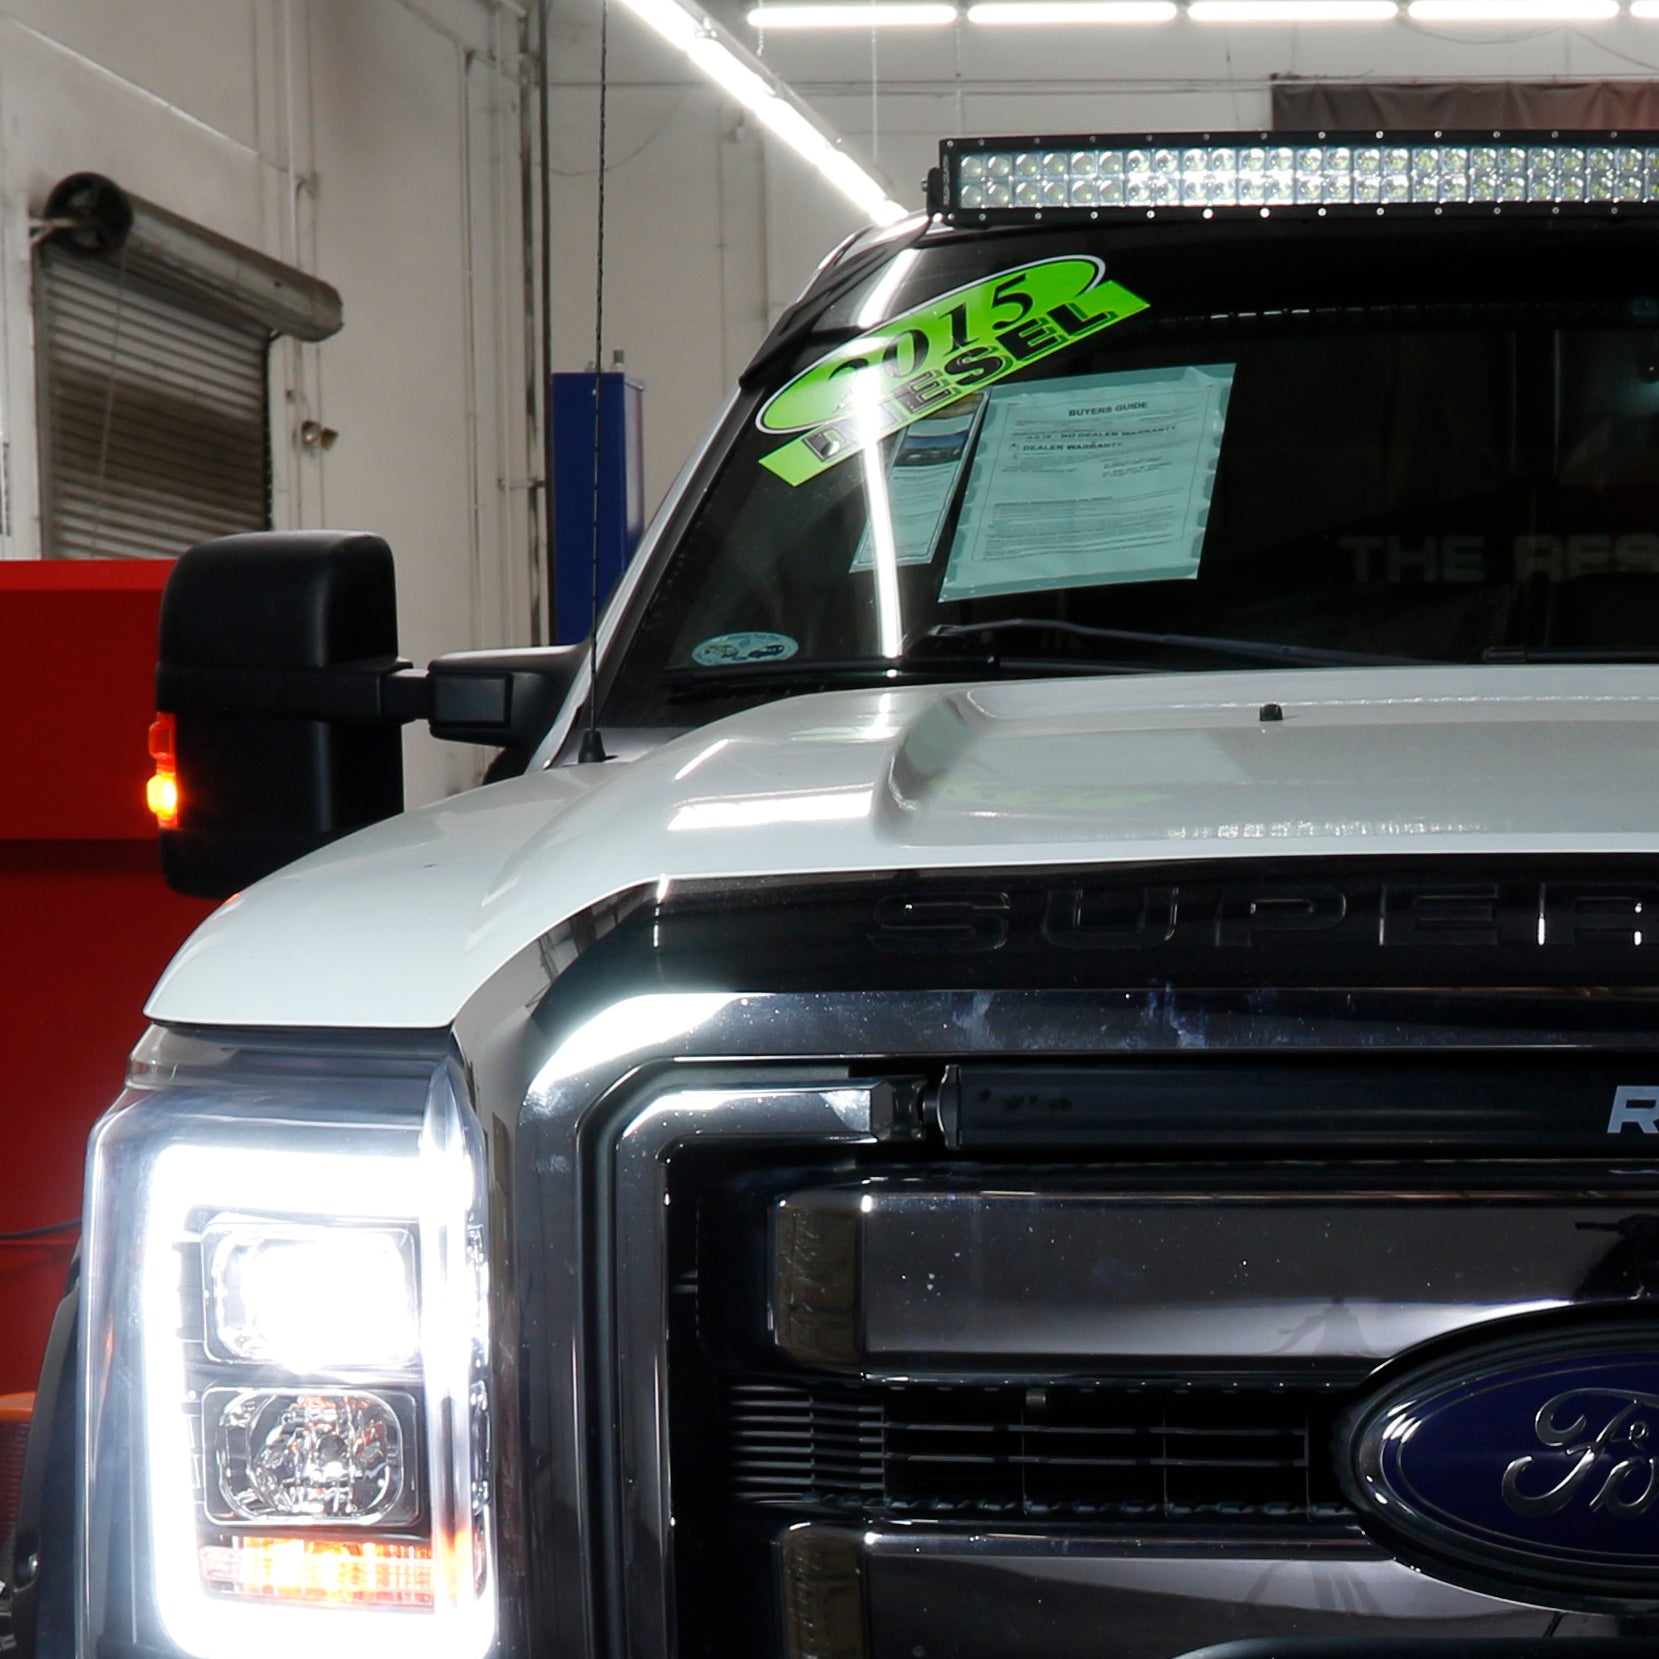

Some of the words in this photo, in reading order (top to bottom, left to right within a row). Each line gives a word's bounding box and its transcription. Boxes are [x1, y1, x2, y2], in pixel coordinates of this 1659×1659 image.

[801, 302, 1117, 462] DESEL
[1069, 406, 1113, 417] BUYERS
[1115, 402, 1149, 412] GUIDE
[1338, 534, 1487, 583] THE
